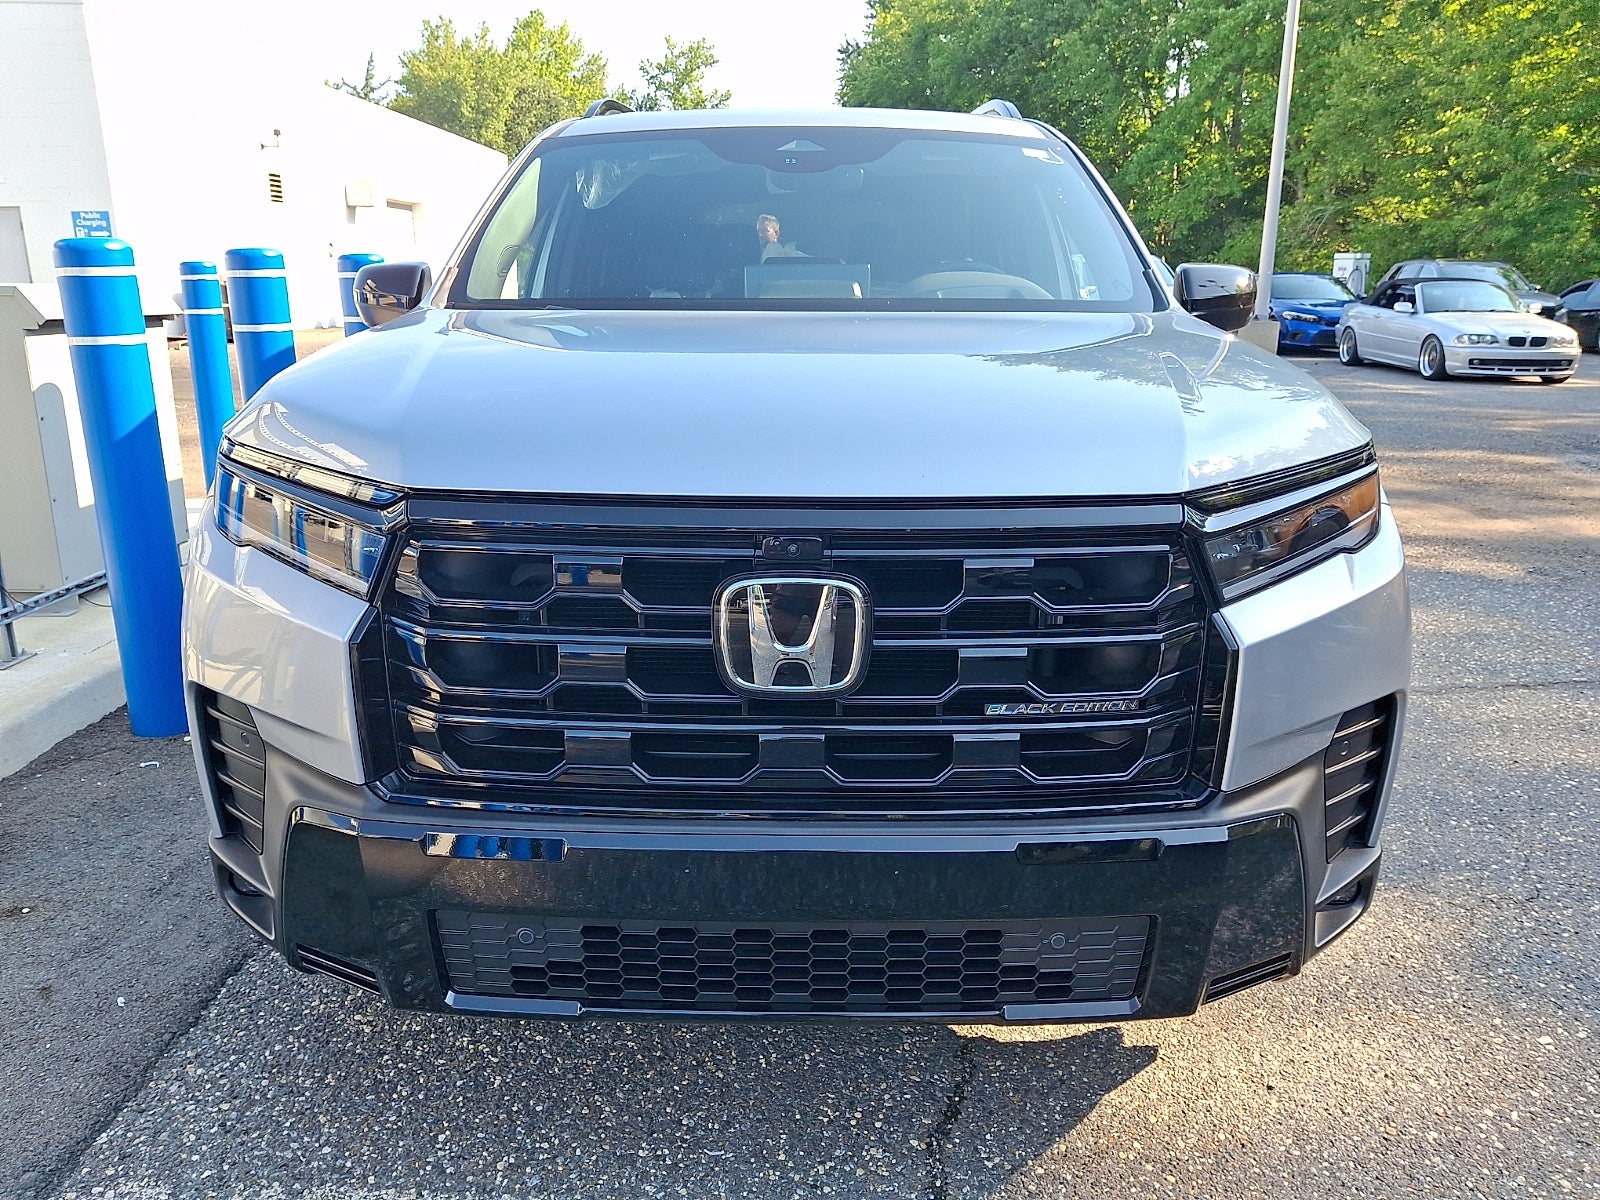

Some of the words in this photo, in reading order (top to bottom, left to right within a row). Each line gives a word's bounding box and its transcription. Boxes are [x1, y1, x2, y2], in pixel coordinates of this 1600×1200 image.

[76, 219, 107, 228] Charging
[985, 703, 1056, 716] BLACK
[1060, 700, 1138, 713] EDITION
